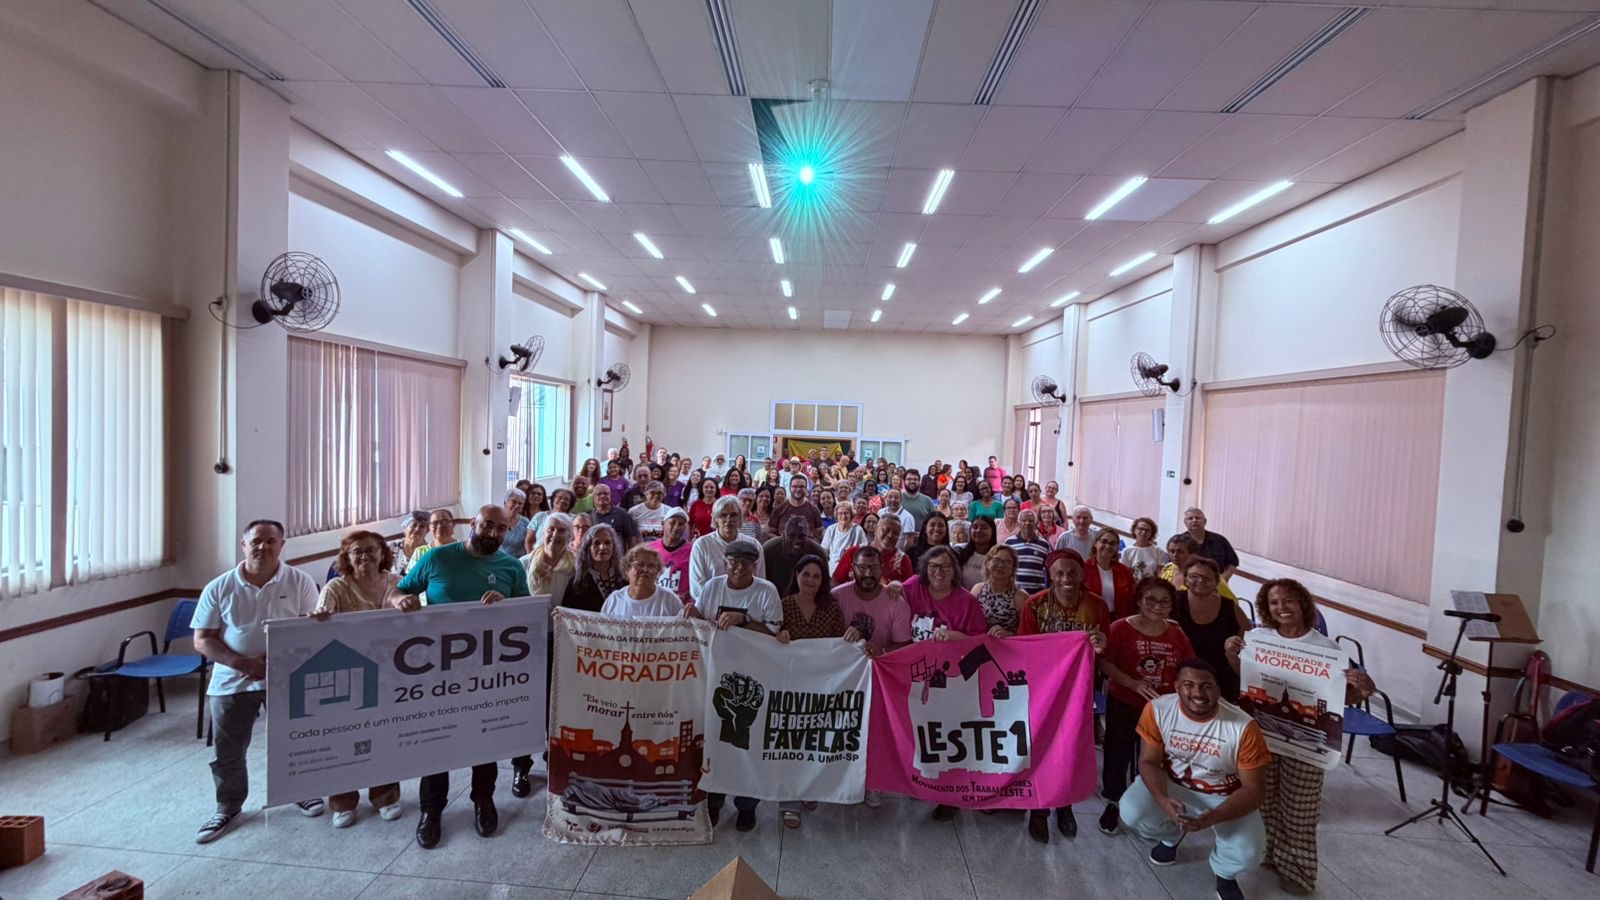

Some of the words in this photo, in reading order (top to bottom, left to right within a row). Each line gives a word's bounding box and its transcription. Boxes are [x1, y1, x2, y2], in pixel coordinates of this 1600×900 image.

[568, 628, 615, 641] CAMPANHA
[616, 635, 627, 643] DA
[628, 635, 690, 644] FRATERNIDADE
[393, 626, 531, 675] CPIS
[576, 645, 687, 664] FRATERNIDADE
[691, 650, 699, 661] E
[1255, 647, 1323, 668] FRATERNIDADE
[576, 656, 698, 683] MORADIA
[1254, 654, 1331, 679] MORADIA
[394, 687, 424, 703] 26
[431, 678, 461, 696] de
[468, 670, 530, 693] Julho
[587, 704, 625, 718] morar
[631, 711, 656, 719] entre
[770, 690, 864, 713] MOVIMENTO
[289, 728, 321, 740] Cada
[322, 721, 362, 736] pessoa
[364, 718, 371, 729] é
[372, 717, 391, 728] um
[392, 710, 428, 724] mundo
[429, 709, 436, 717] e
[437, 704, 460, 716] todo
[460, 700, 494, 713] mundo
[495, 694, 530, 709] importa
[770, 711, 785, 729] DE
[787, 711, 832, 730] DEFESA
[834, 711, 858, 729] DAS
[763, 729, 860, 753] FAVELAS
[762, 752, 804, 761] FILIADO
[807, 754, 815, 762] A
[818, 753, 859, 764] UMM-SP
[911, 774, 955, 793] MOVIMENTO
